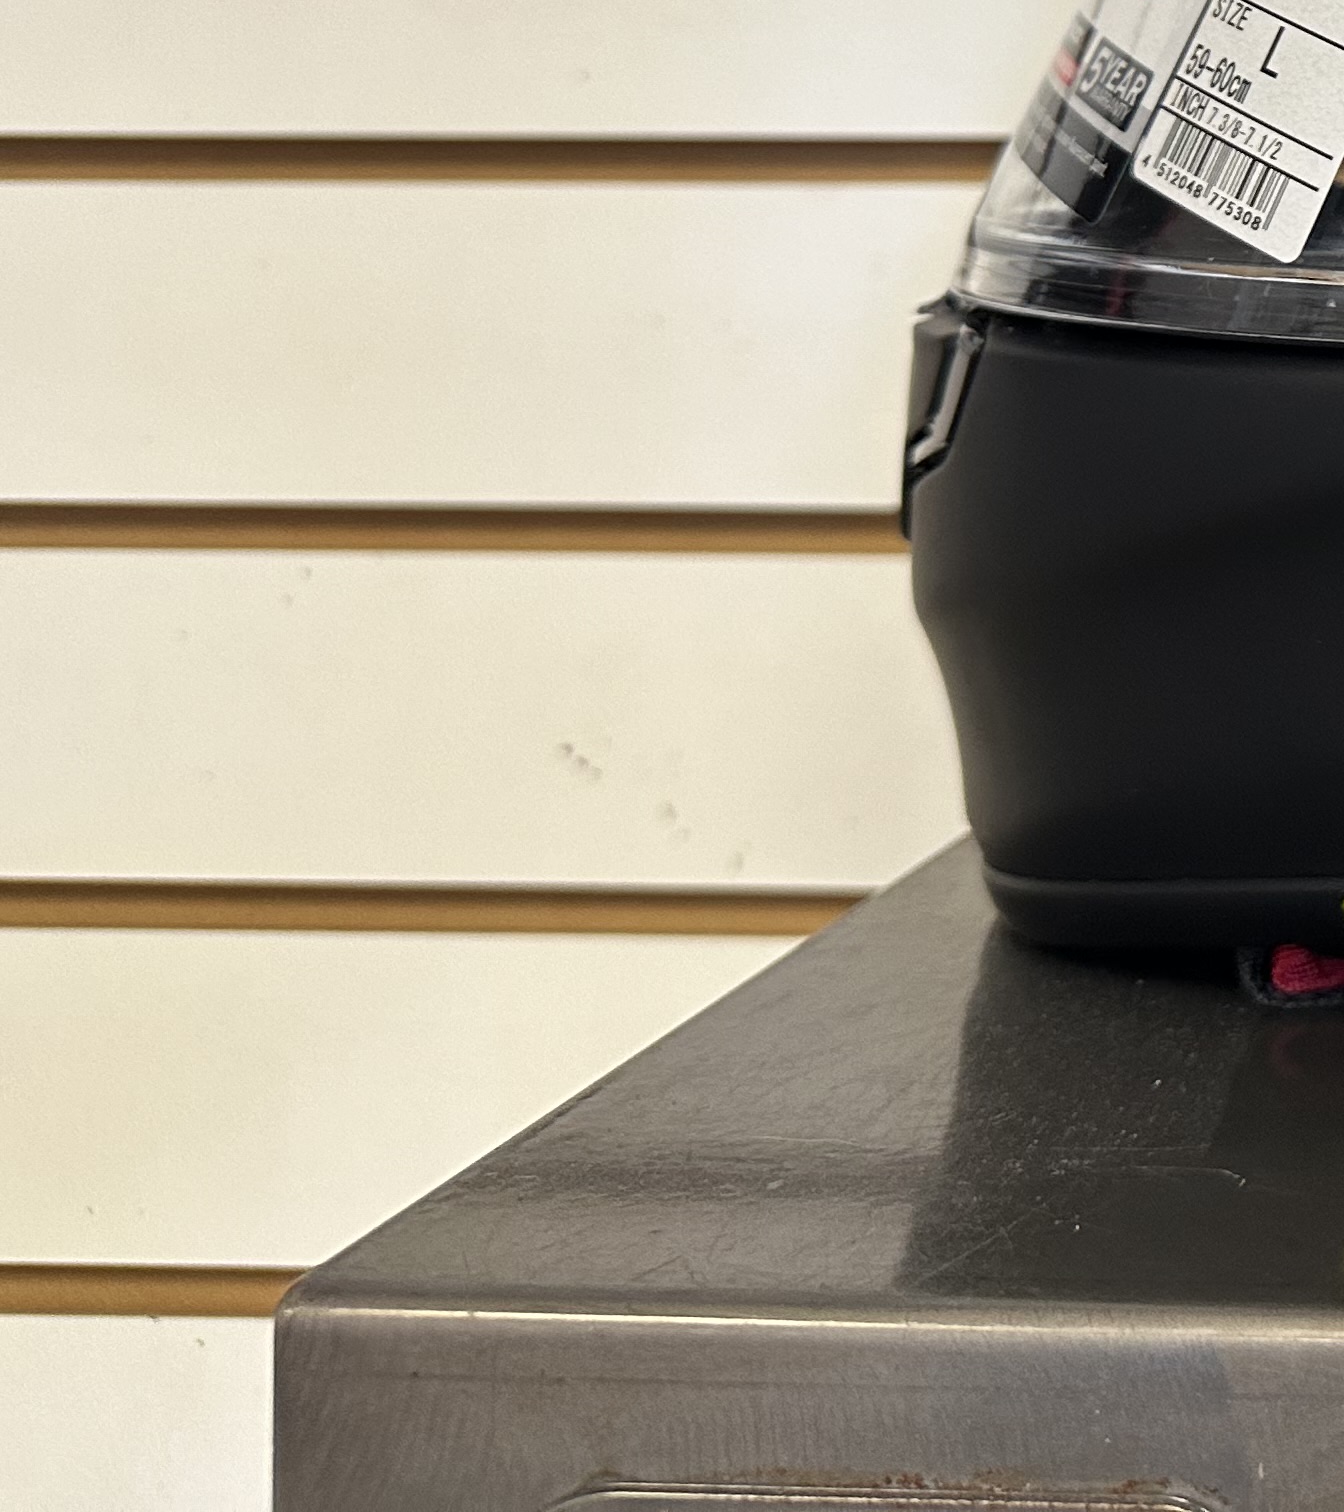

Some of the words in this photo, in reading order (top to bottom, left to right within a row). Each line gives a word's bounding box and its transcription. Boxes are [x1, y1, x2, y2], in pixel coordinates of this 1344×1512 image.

[1081, 46, 1109, 92] 5
[1101, 54, 1147, 106] YEAR
[1185, 44, 1252, 104] 59-60cm
[1260, 26, 1285, 79] L
[1170, 84, 1209, 121] INCH
[1142, 154, 1152, 168] 4
[1157, 162, 1204, 199] 512048
[1208, 192, 1262, 231] 775308
